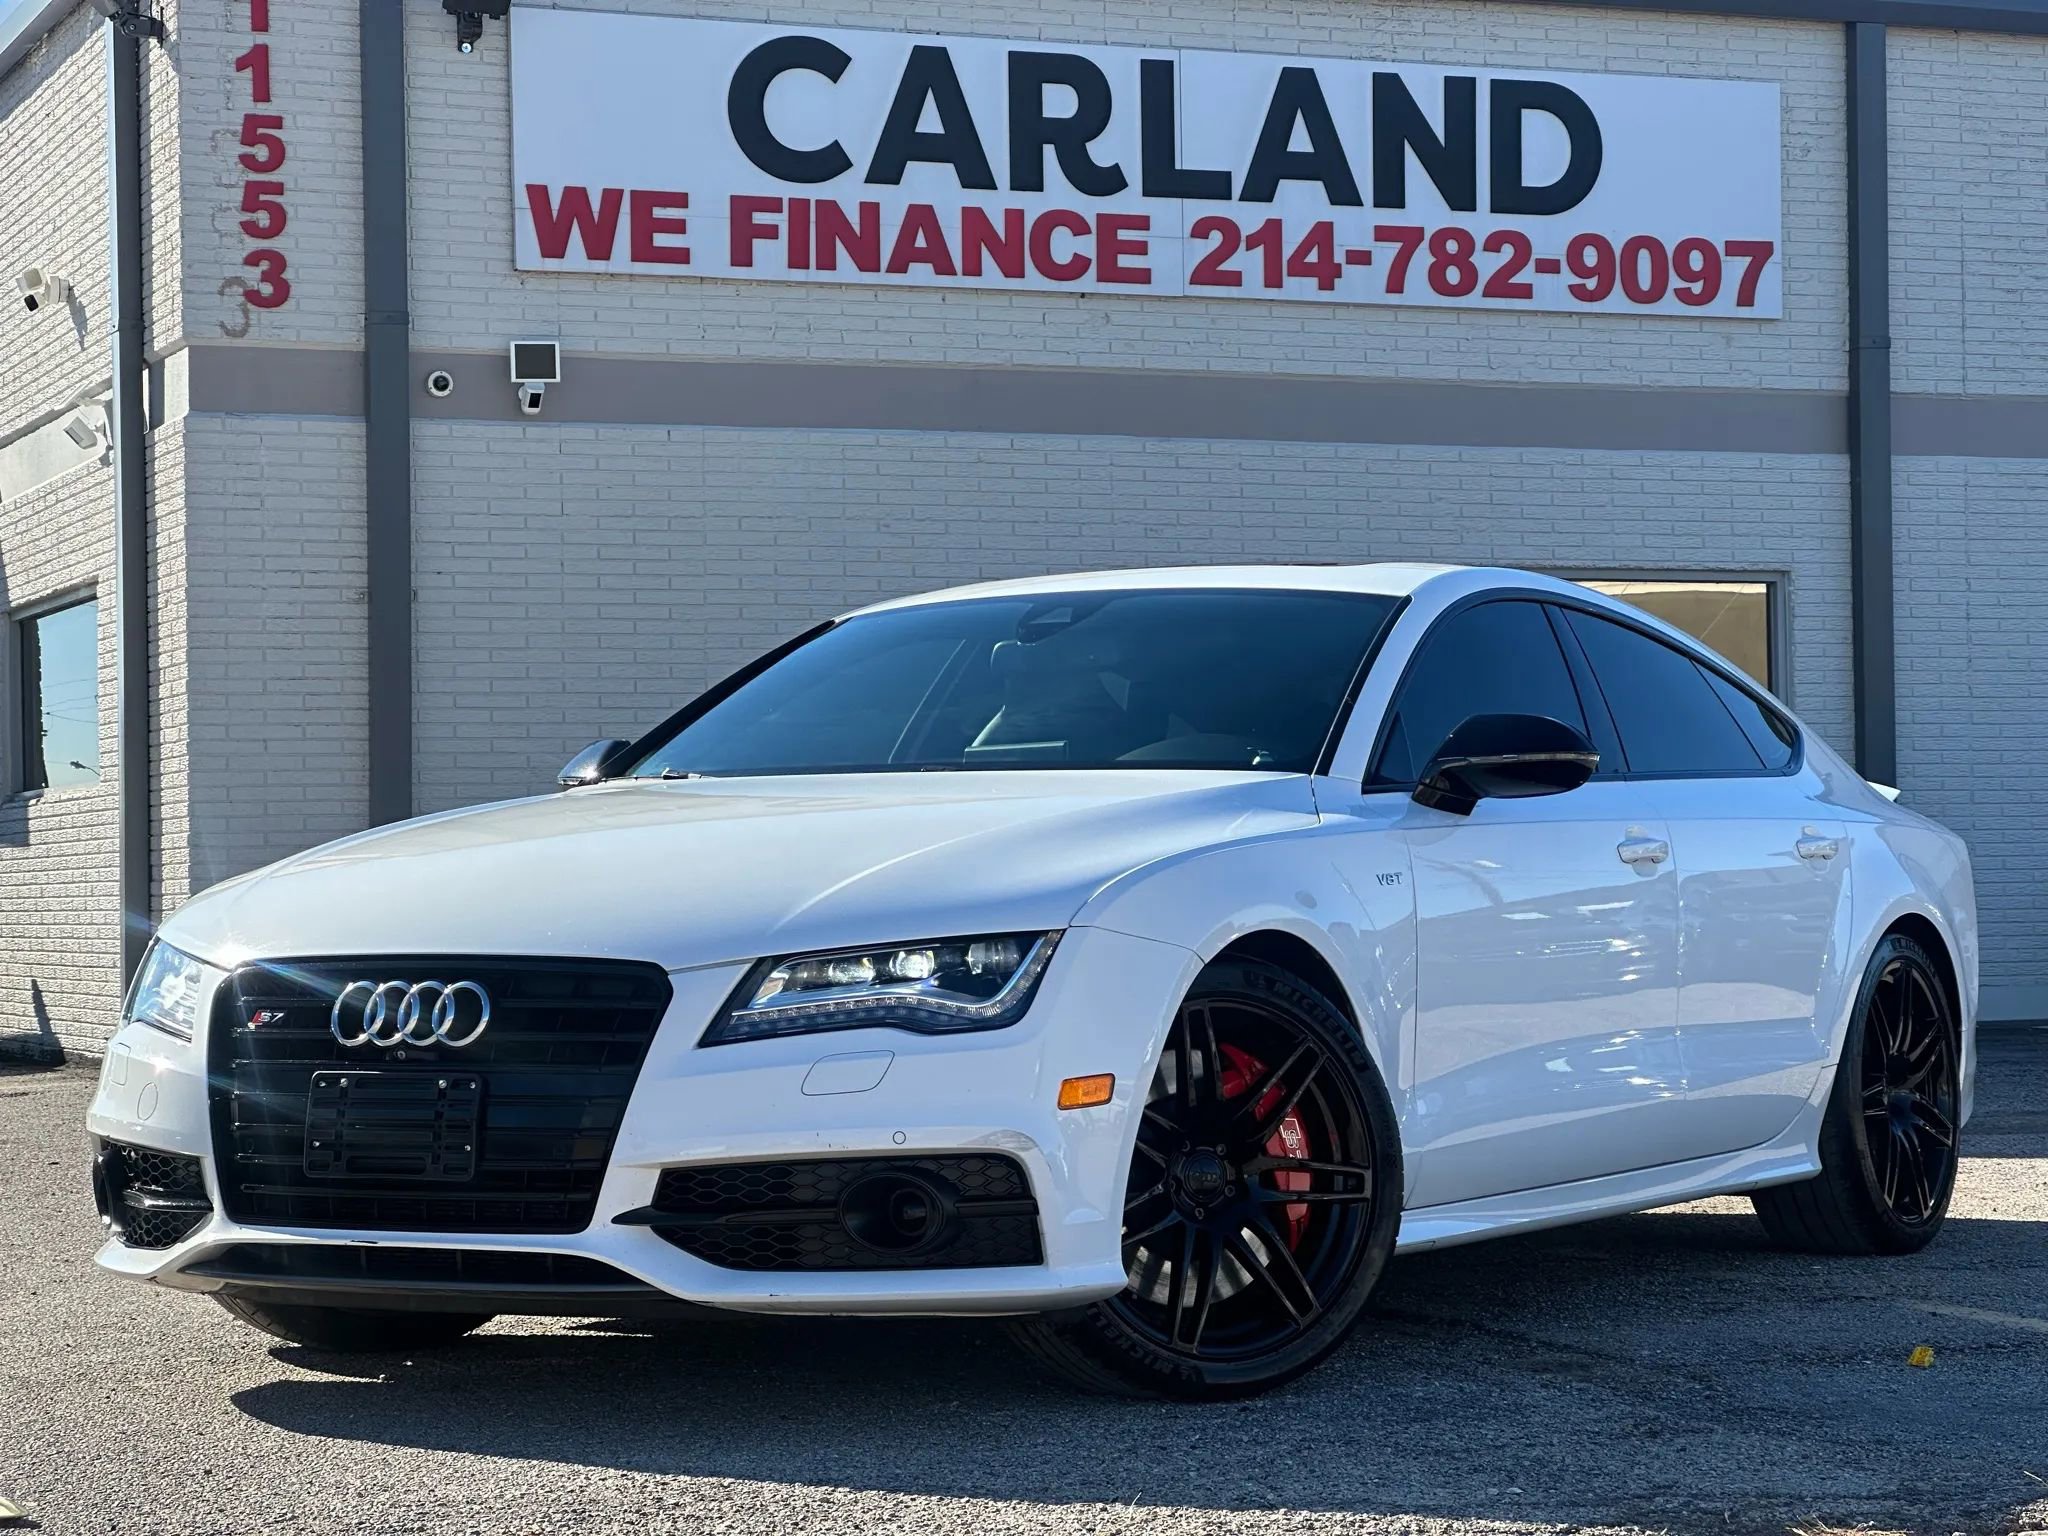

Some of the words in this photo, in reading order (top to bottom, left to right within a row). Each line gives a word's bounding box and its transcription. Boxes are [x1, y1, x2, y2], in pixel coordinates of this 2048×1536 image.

[727, 35, 1603, 217] CARLAND
[525, 184, 691, 265] WE
[729, 194, 1152, 285] FINANCE
[1189, 215, 1775, 308] 214-782-9097
[1272, 977, 1369, 1070] MICHELIN
